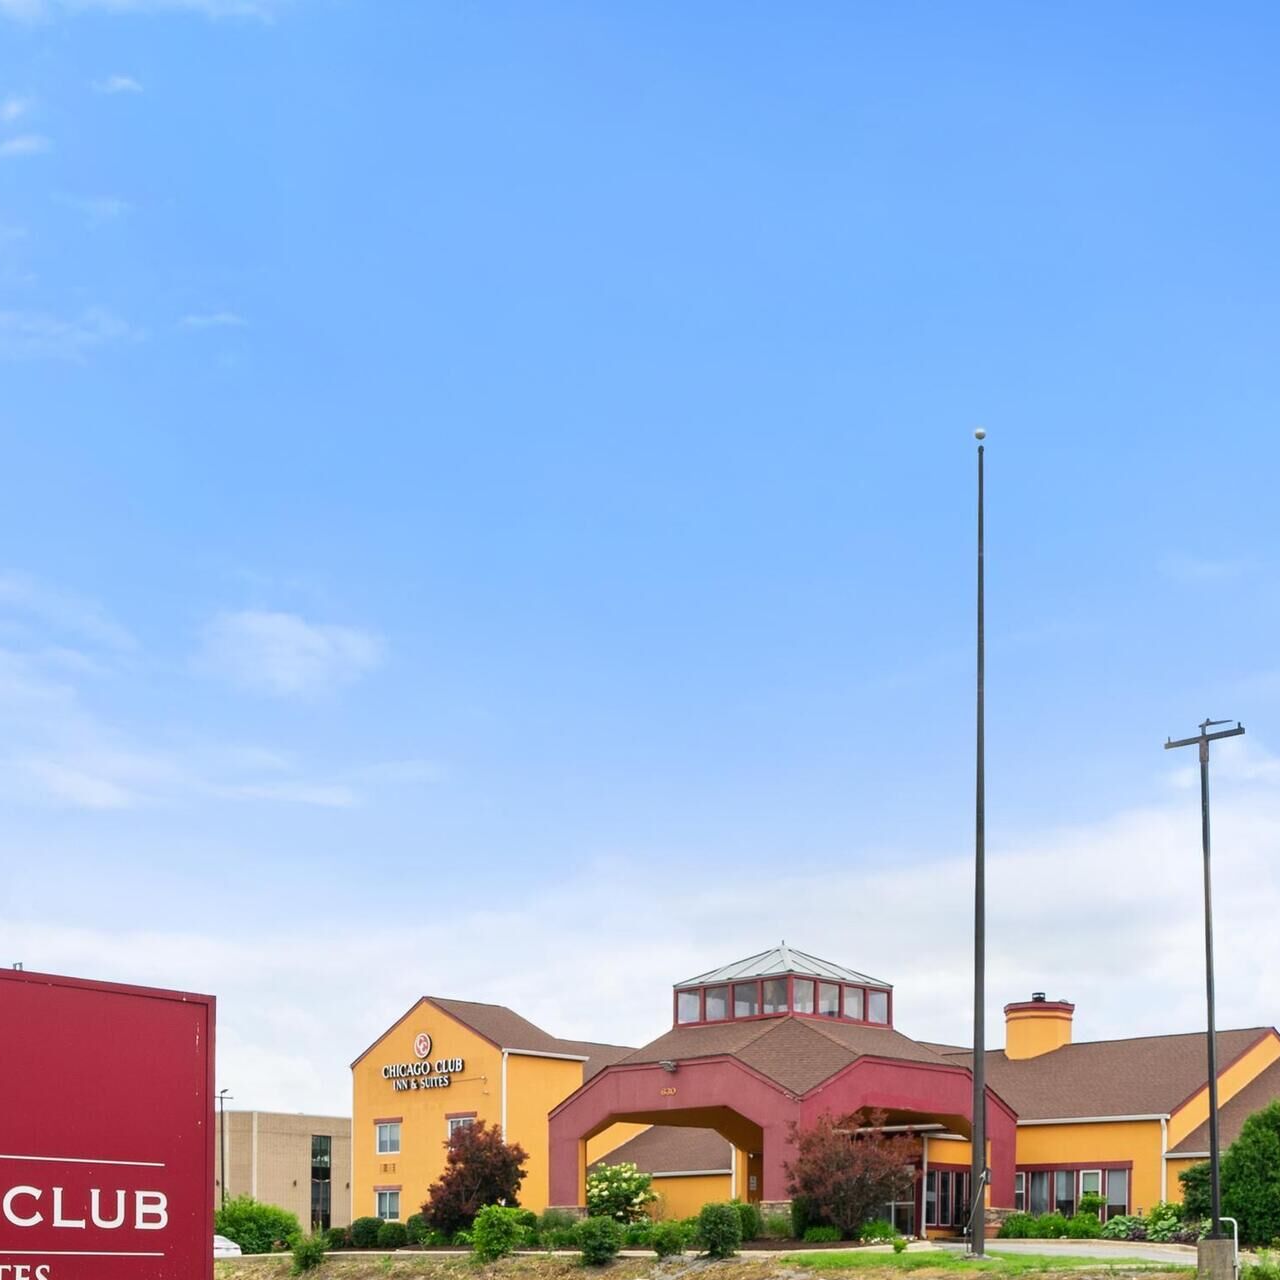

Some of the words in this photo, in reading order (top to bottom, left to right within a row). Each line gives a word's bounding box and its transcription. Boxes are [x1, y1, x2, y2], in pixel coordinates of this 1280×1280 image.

[382, 1061, 430, 1078] CHICAGO
[435, 1058, 463, 1074] CLUB
[393, 1079, 408, 1091] INN
[411, 1078, 418, 1089] &
[421, 1075, 449, 1089] SUITES
[3, 1185, 169, 1230] CLUB
